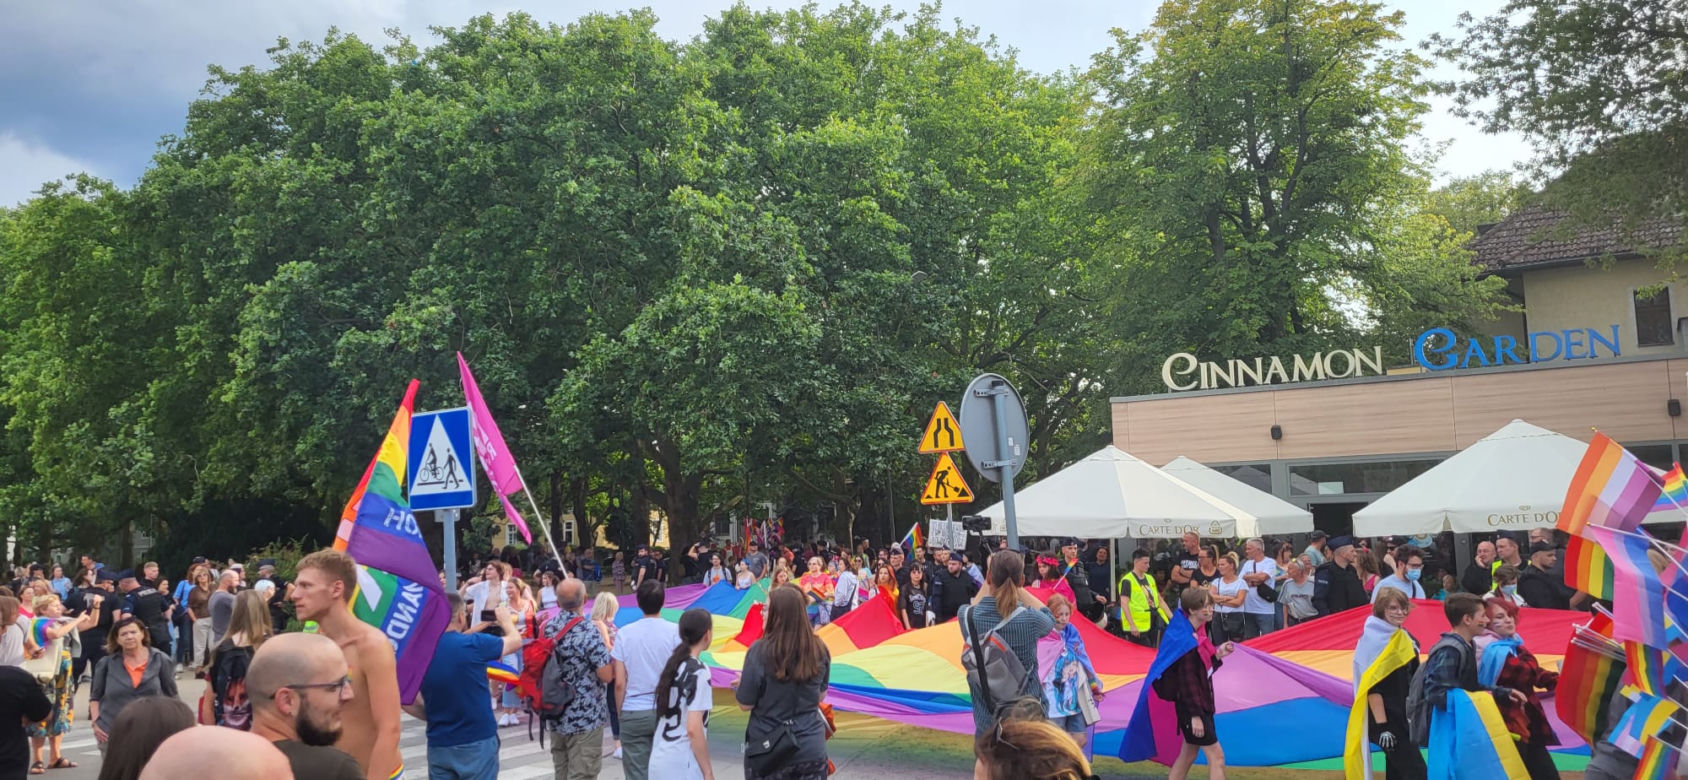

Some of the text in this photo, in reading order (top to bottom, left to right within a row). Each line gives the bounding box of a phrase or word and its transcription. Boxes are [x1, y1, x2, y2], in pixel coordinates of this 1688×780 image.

[1162, 324, 1621, 391] CINNAMON GARDEN
[384, 507, 422, 538] HO
[1488, 510, 1561, 526] CARTE D'O
[1139, 524, 1170, 536] CARTE
